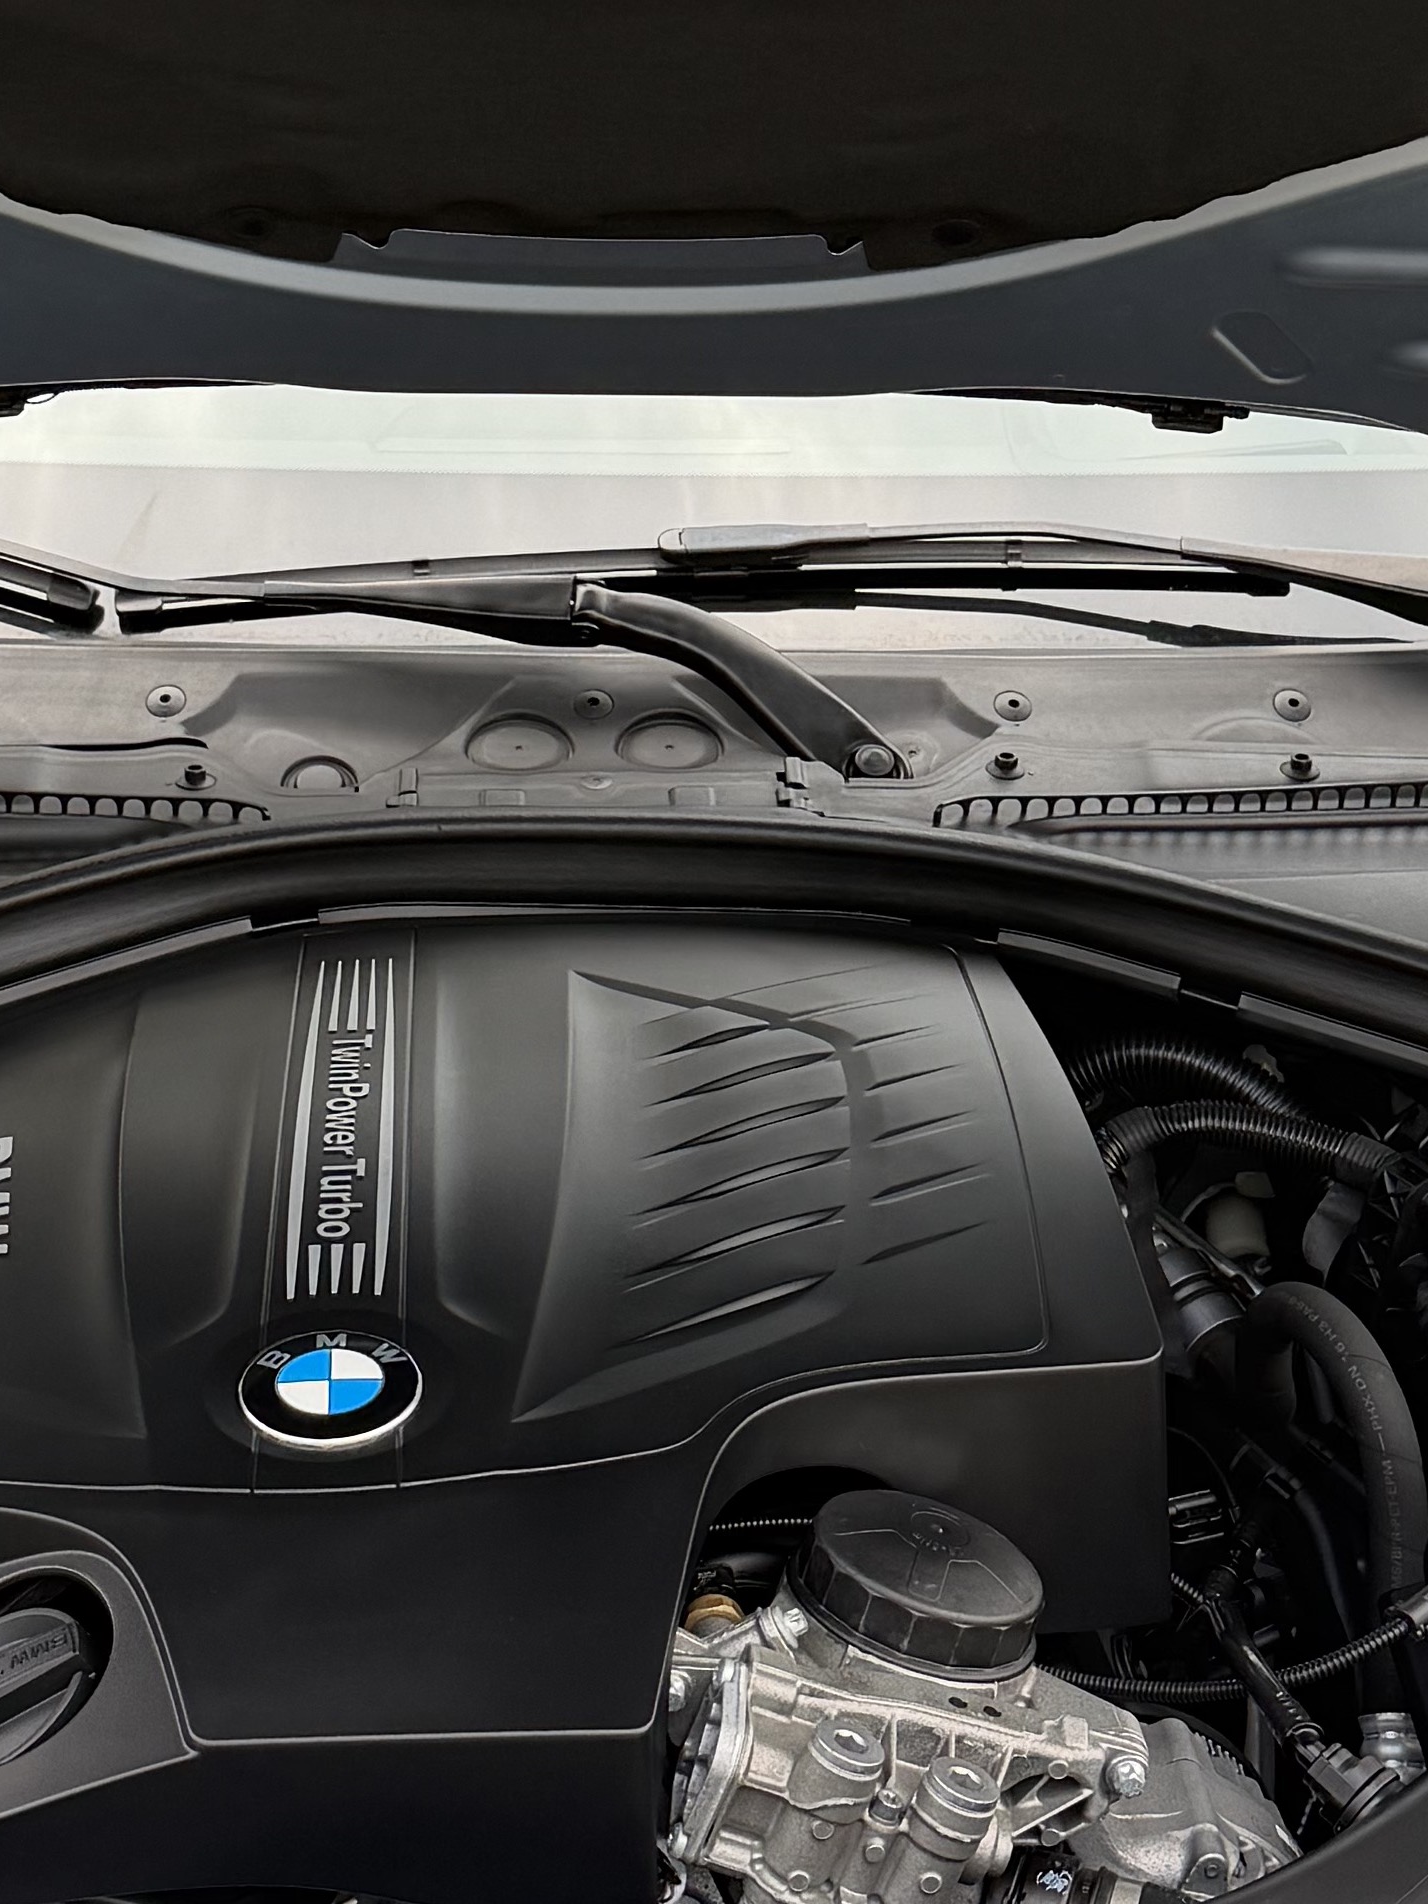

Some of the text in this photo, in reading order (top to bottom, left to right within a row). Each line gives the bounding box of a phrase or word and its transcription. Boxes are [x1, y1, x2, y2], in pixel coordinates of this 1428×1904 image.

[316, 1034, 373, 1240] TwinPower Turbo
[257, 1332, 409, 1369] BMW
